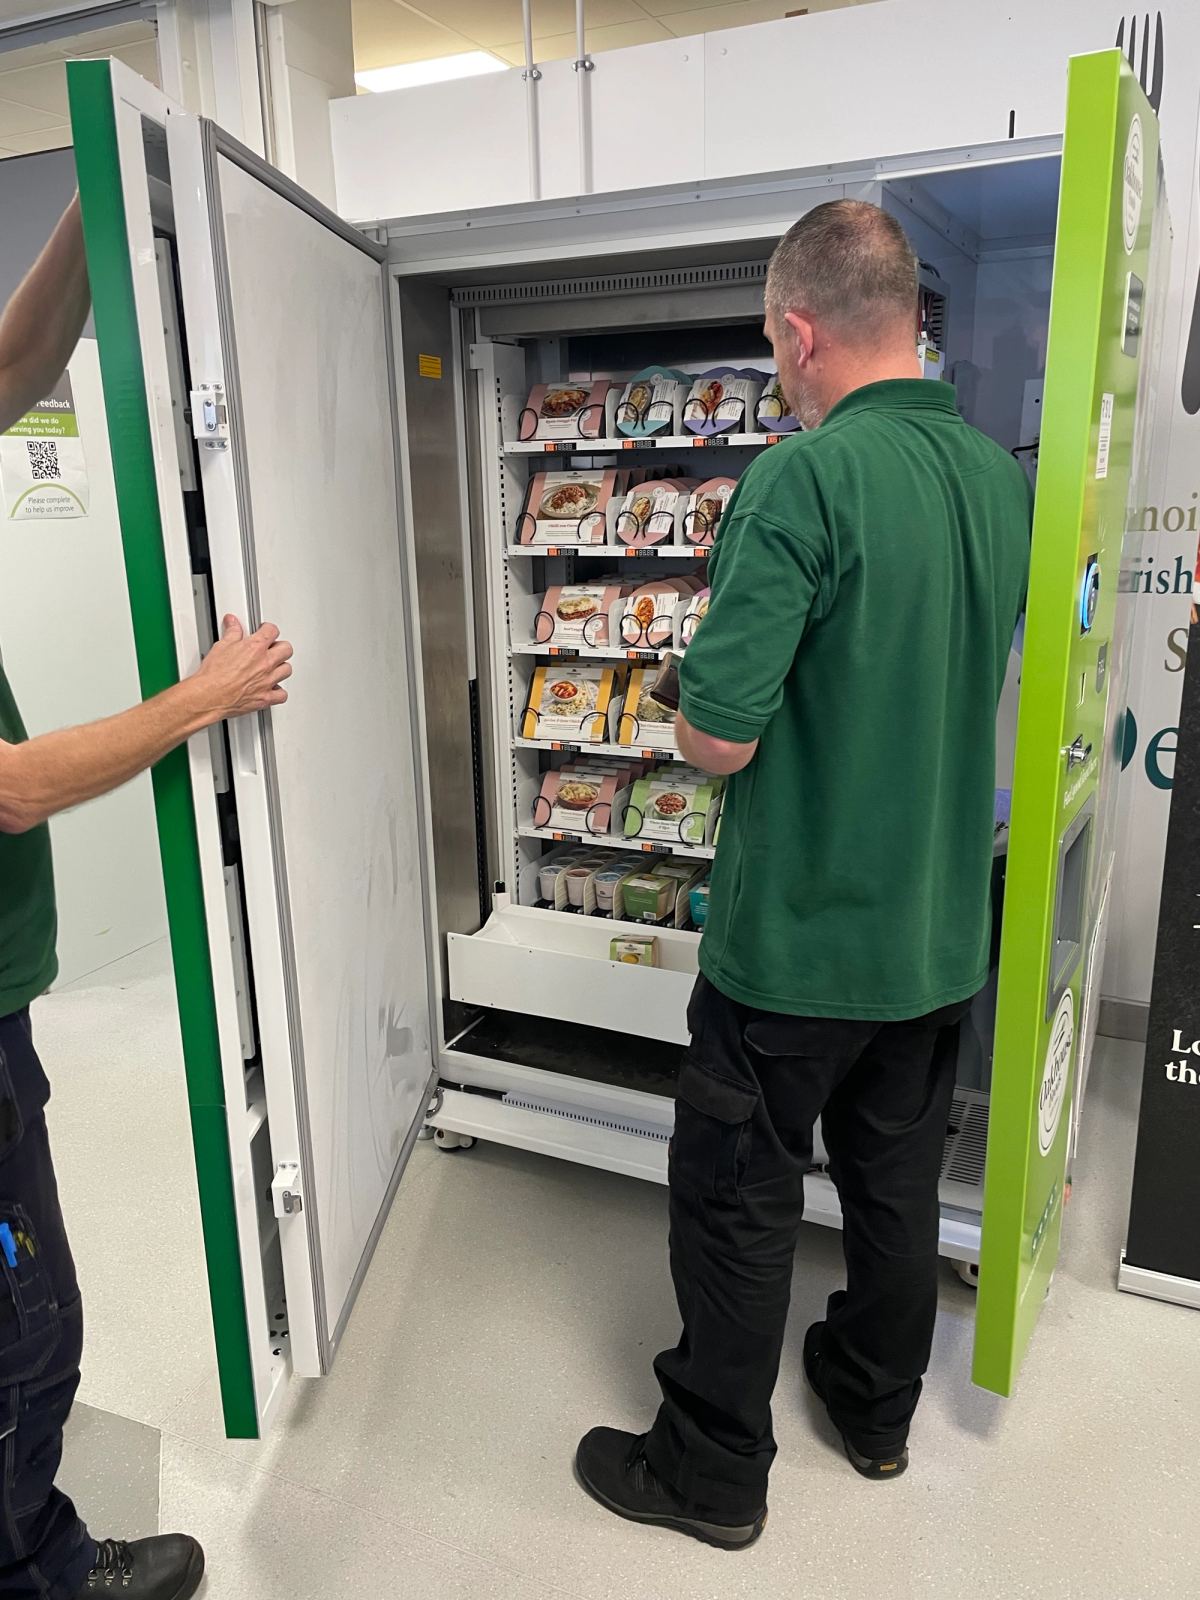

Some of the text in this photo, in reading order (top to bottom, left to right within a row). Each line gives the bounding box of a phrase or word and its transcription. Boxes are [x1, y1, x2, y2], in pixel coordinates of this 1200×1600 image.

[29, 416, 39, 424] did
[10, 425, 66, 435] serving you today?
[47, 496, 71, 504] complete
[32, 506, 45, 514] help
[54, 505, 74, 513] improve
[1164, 1060, 1200, 1085] th
